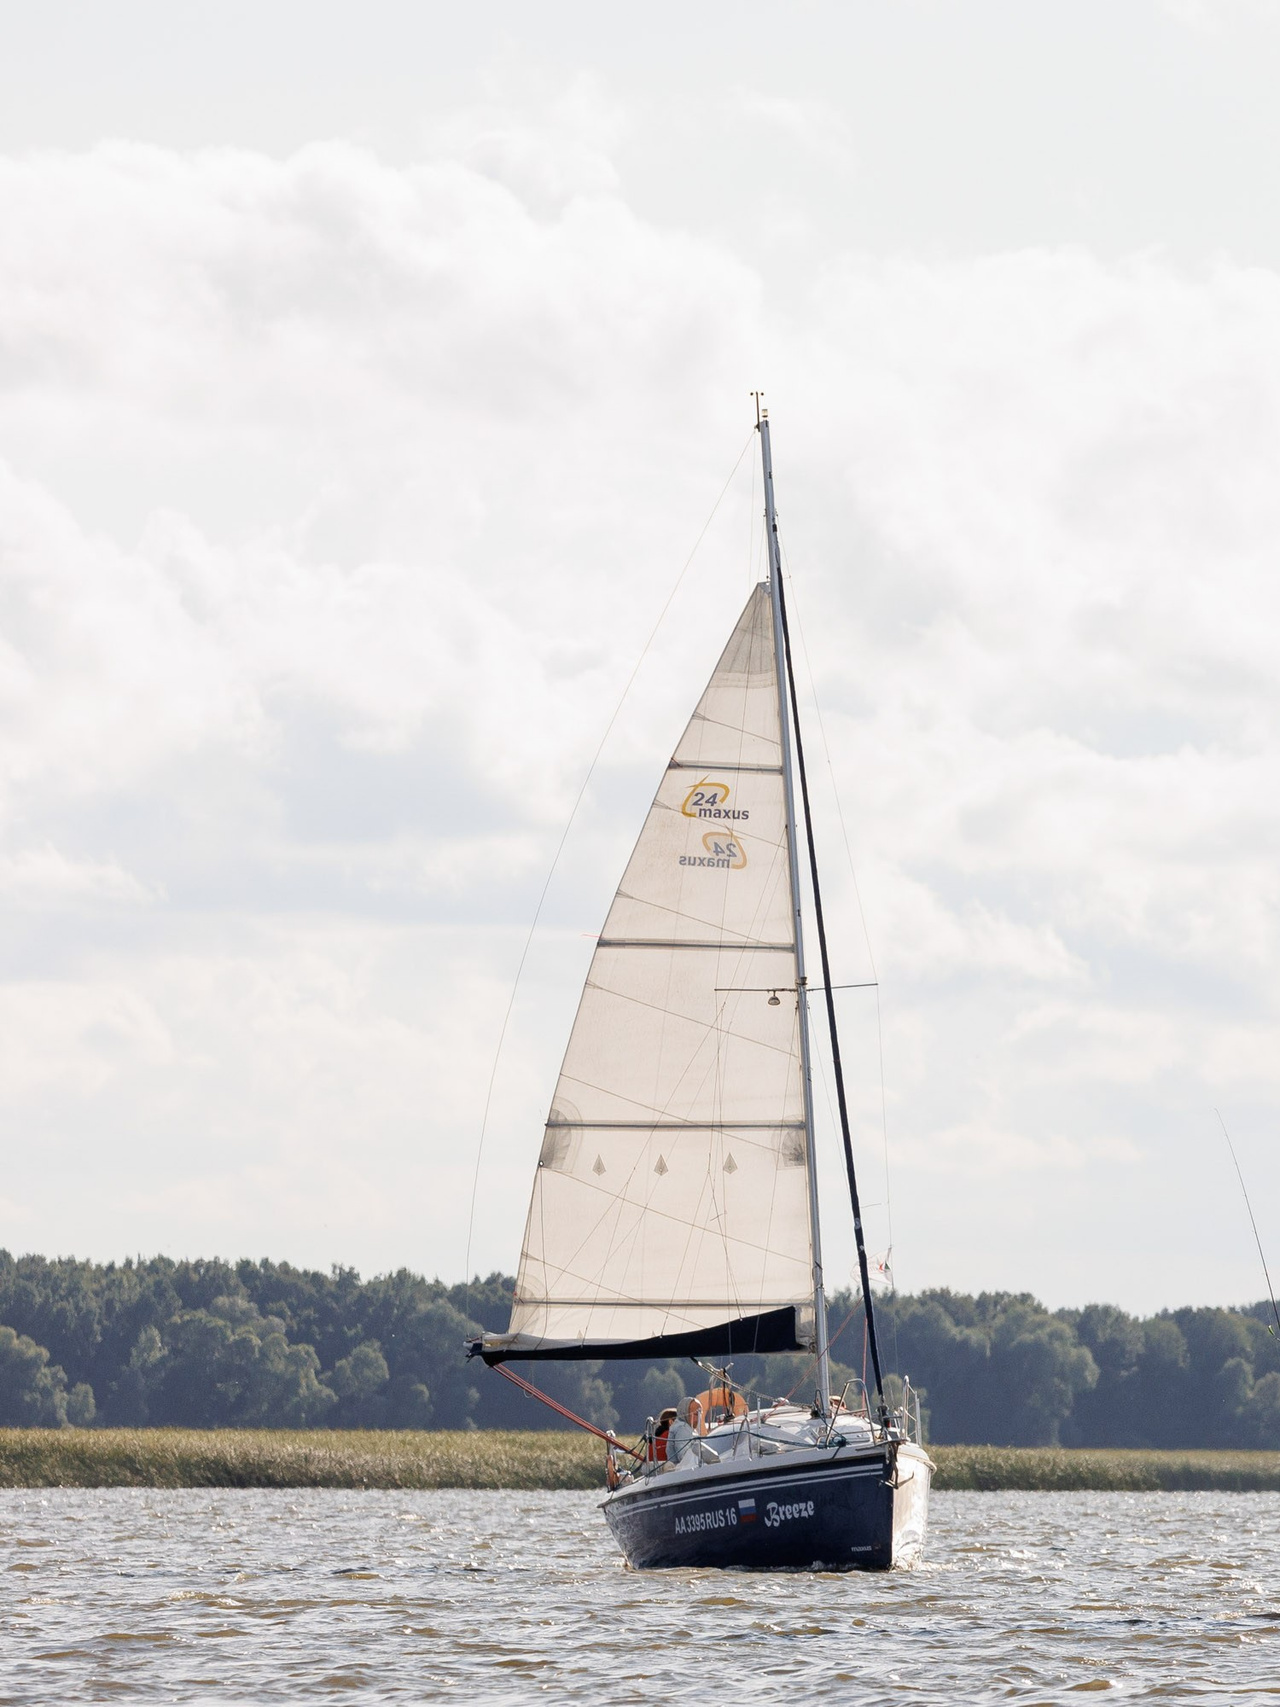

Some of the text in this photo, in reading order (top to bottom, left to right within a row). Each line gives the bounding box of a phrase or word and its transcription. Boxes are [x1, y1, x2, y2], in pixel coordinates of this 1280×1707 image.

[692, 792, 718, 807] 24
[698, 808, 749, 820] maxus
[764, 1501, 815, 1527] Breeze
